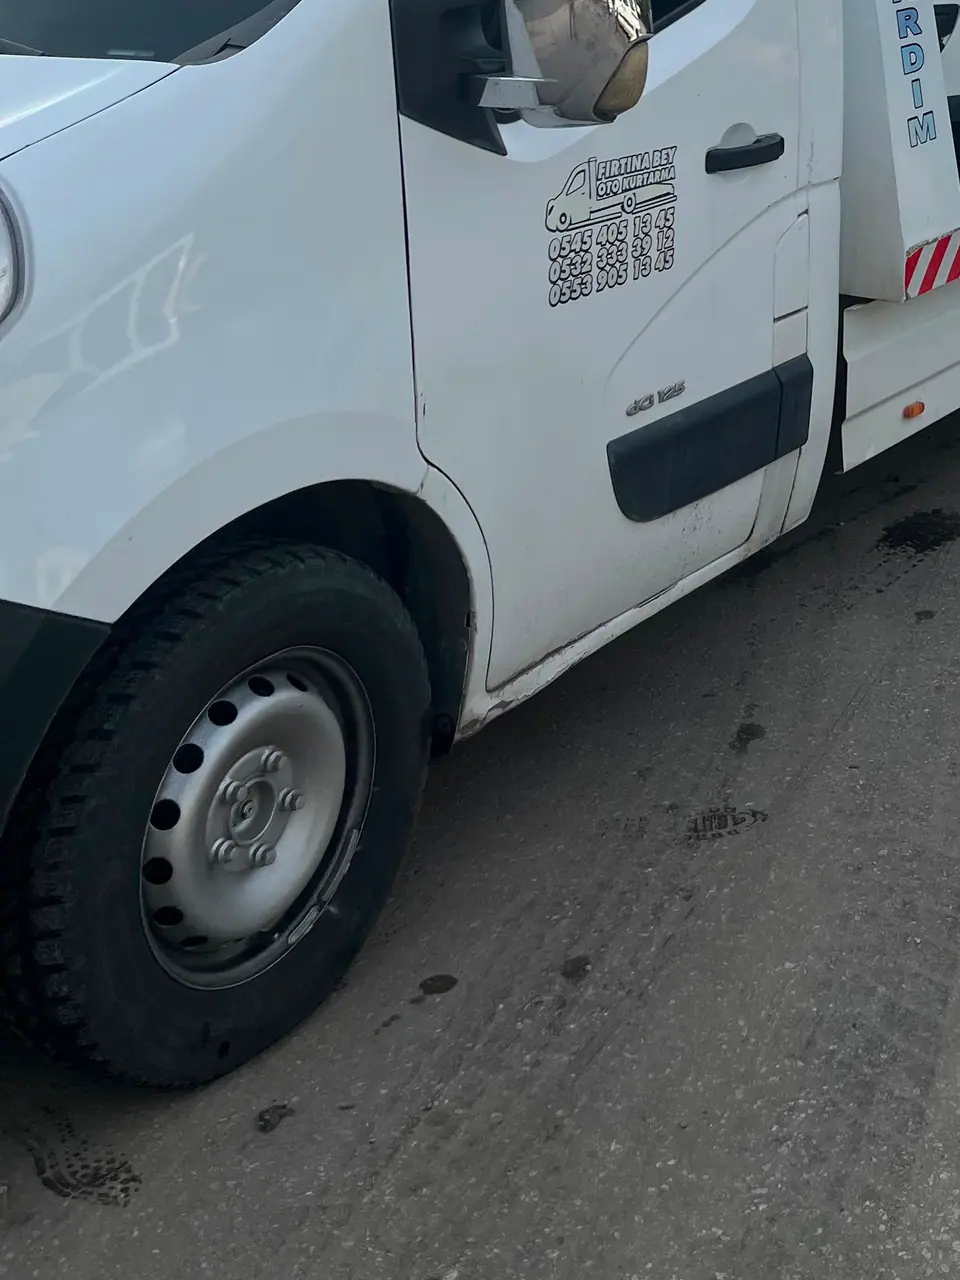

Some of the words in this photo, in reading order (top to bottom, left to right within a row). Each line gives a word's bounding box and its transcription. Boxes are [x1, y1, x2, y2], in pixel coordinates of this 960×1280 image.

[597, 152, 651, 181] FIRTINA
[652, 146, 677, 168] BEY
[597, 179, 620, 198] OTO
[622, 165, 675, 193] KURTARMA
[548, 229, 593, 261] 0545
[596, 220, 628, 246] 405
[633, 213, 652, 237] 13
[655, 206, 675, 229] 45
[549, 252, 593, 284] 0532
[596, 241, 628, 269] 333
[631, 234, 652, 258] 39
[657, 228, 675, 252] 12
[549, 274, 593, 307] 0553
[596, 263, 628, 292] 905
[633, 255, 652, 280] 13
[654, 248, 675, 272] 45
[657, 379, 686, 404] 125
